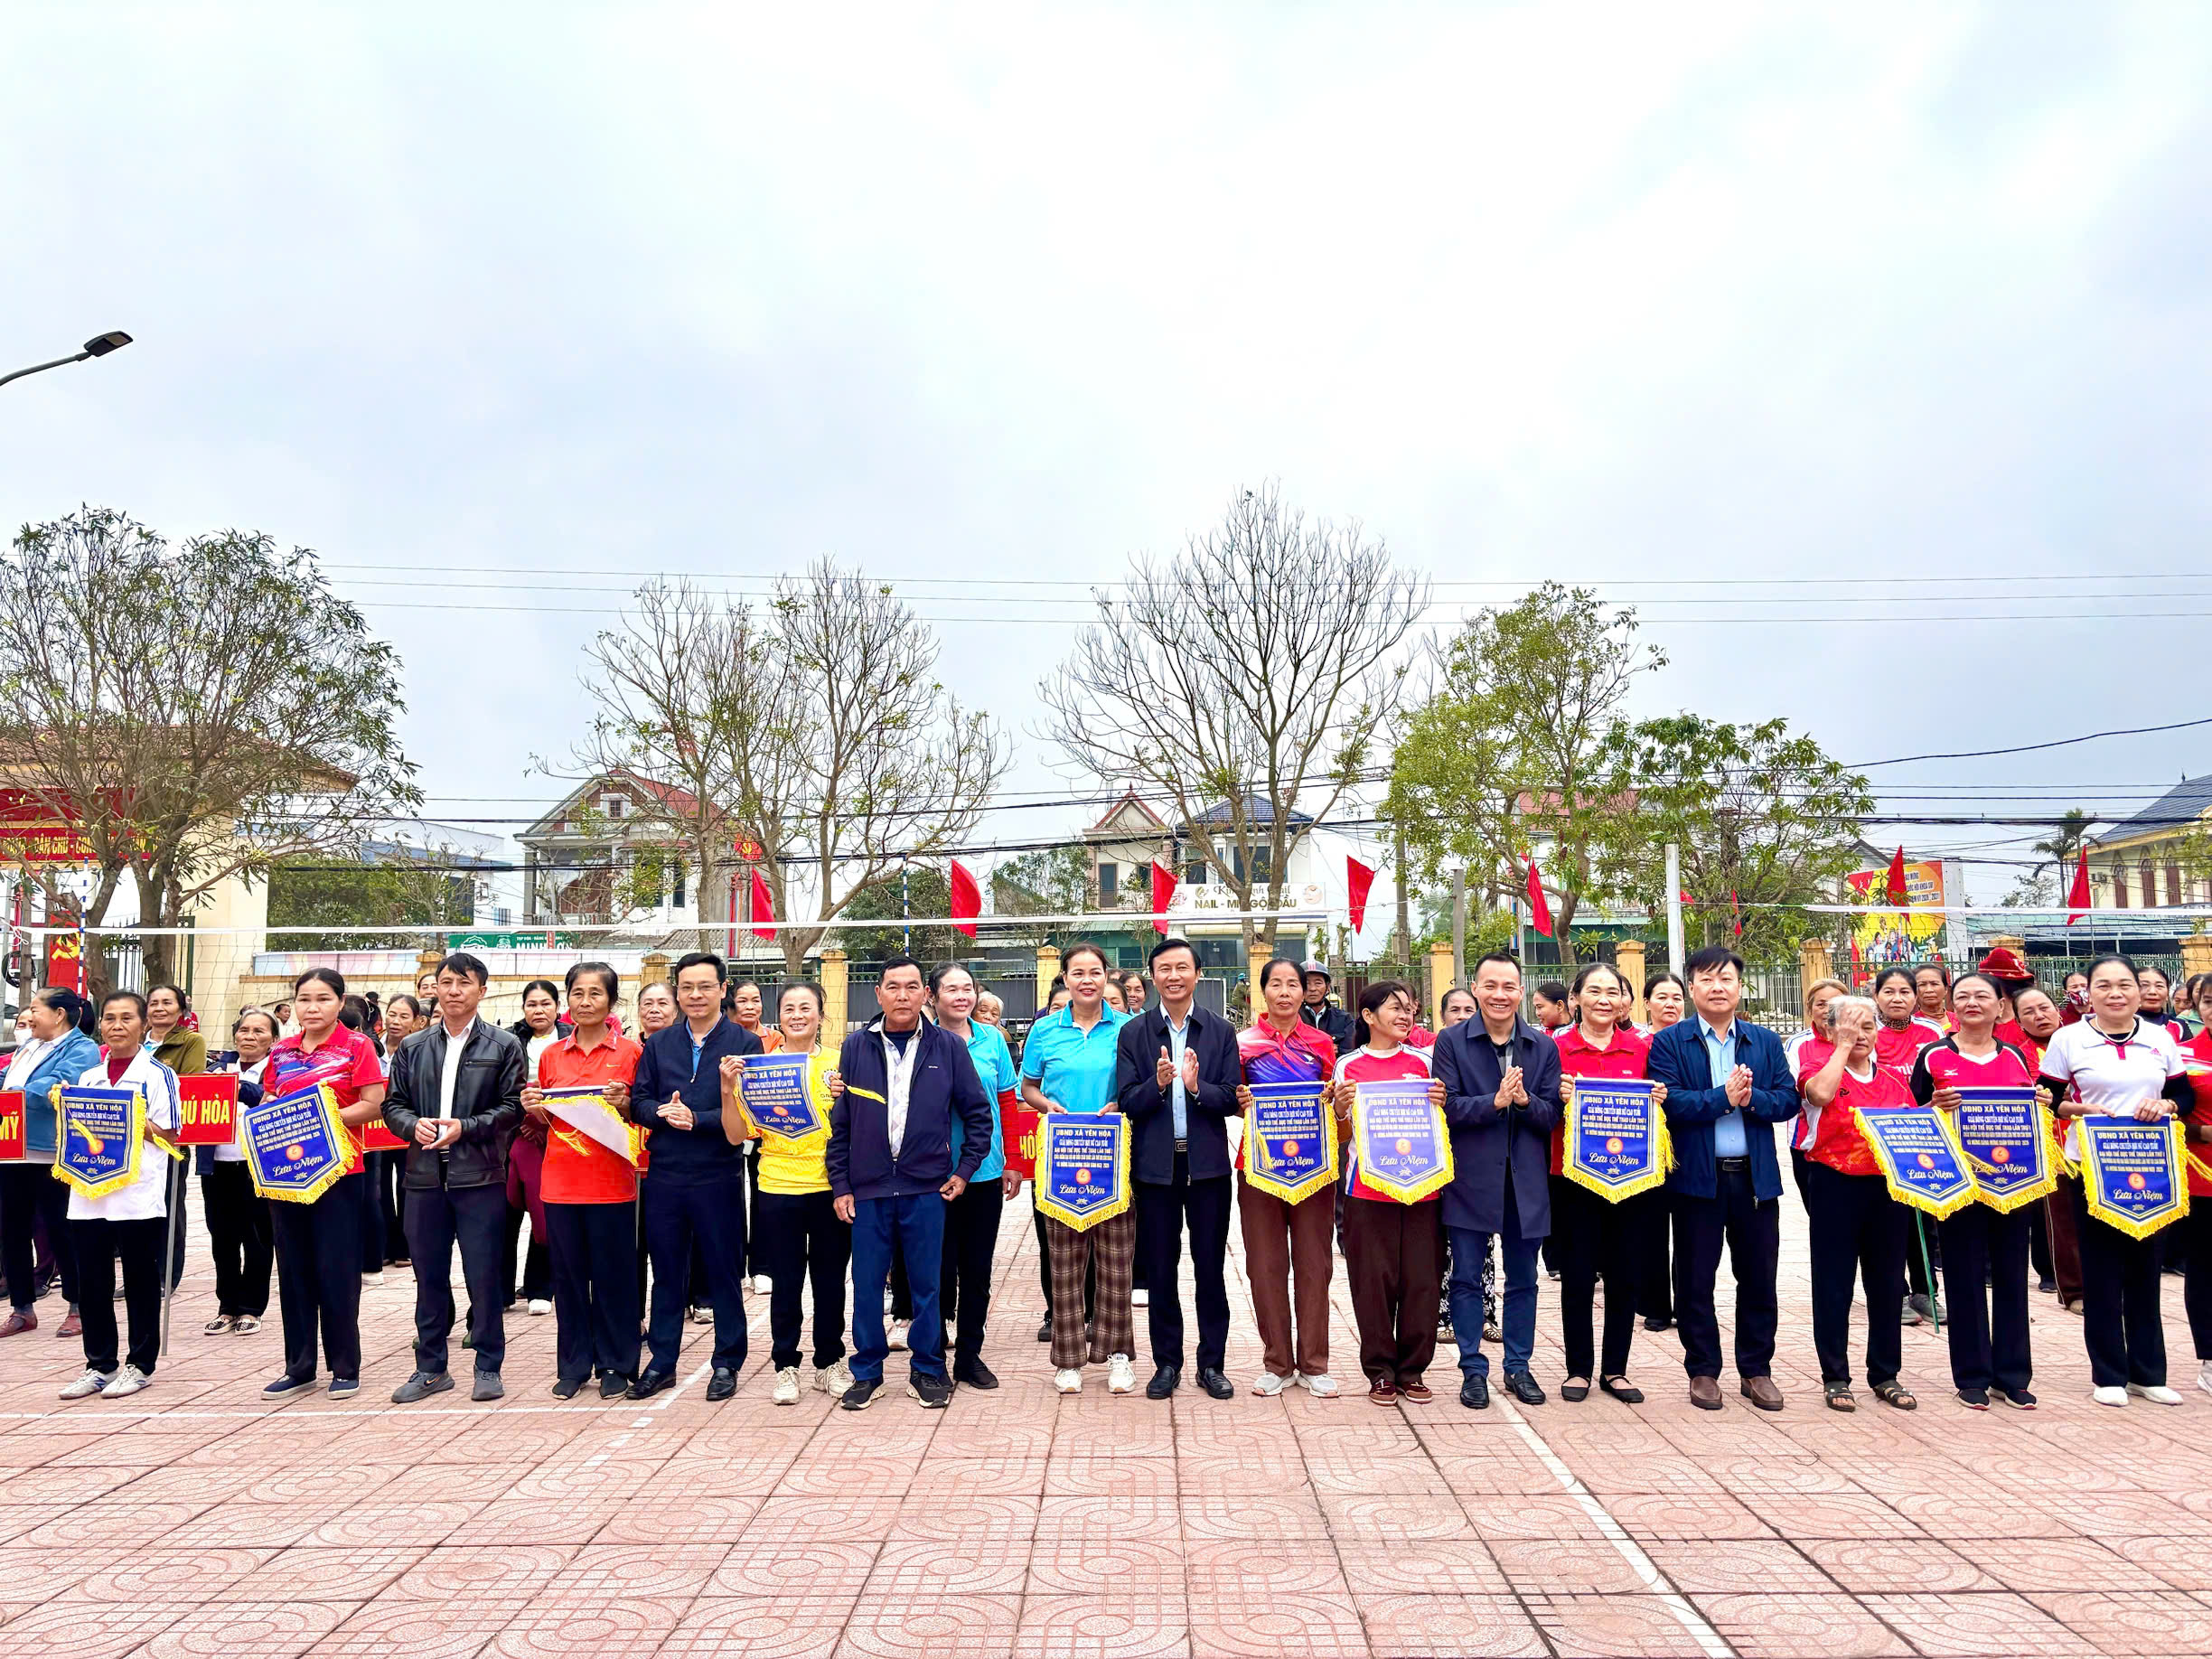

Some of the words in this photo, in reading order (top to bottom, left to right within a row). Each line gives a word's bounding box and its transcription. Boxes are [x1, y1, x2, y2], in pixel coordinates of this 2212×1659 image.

[1195, 900, 1218, 909] NAIL
[1251, 896, 1268, 911] GỘ
[181, 1094, 198, 1125] HÚ
[201, 1092, 230, 1125] HÒA
